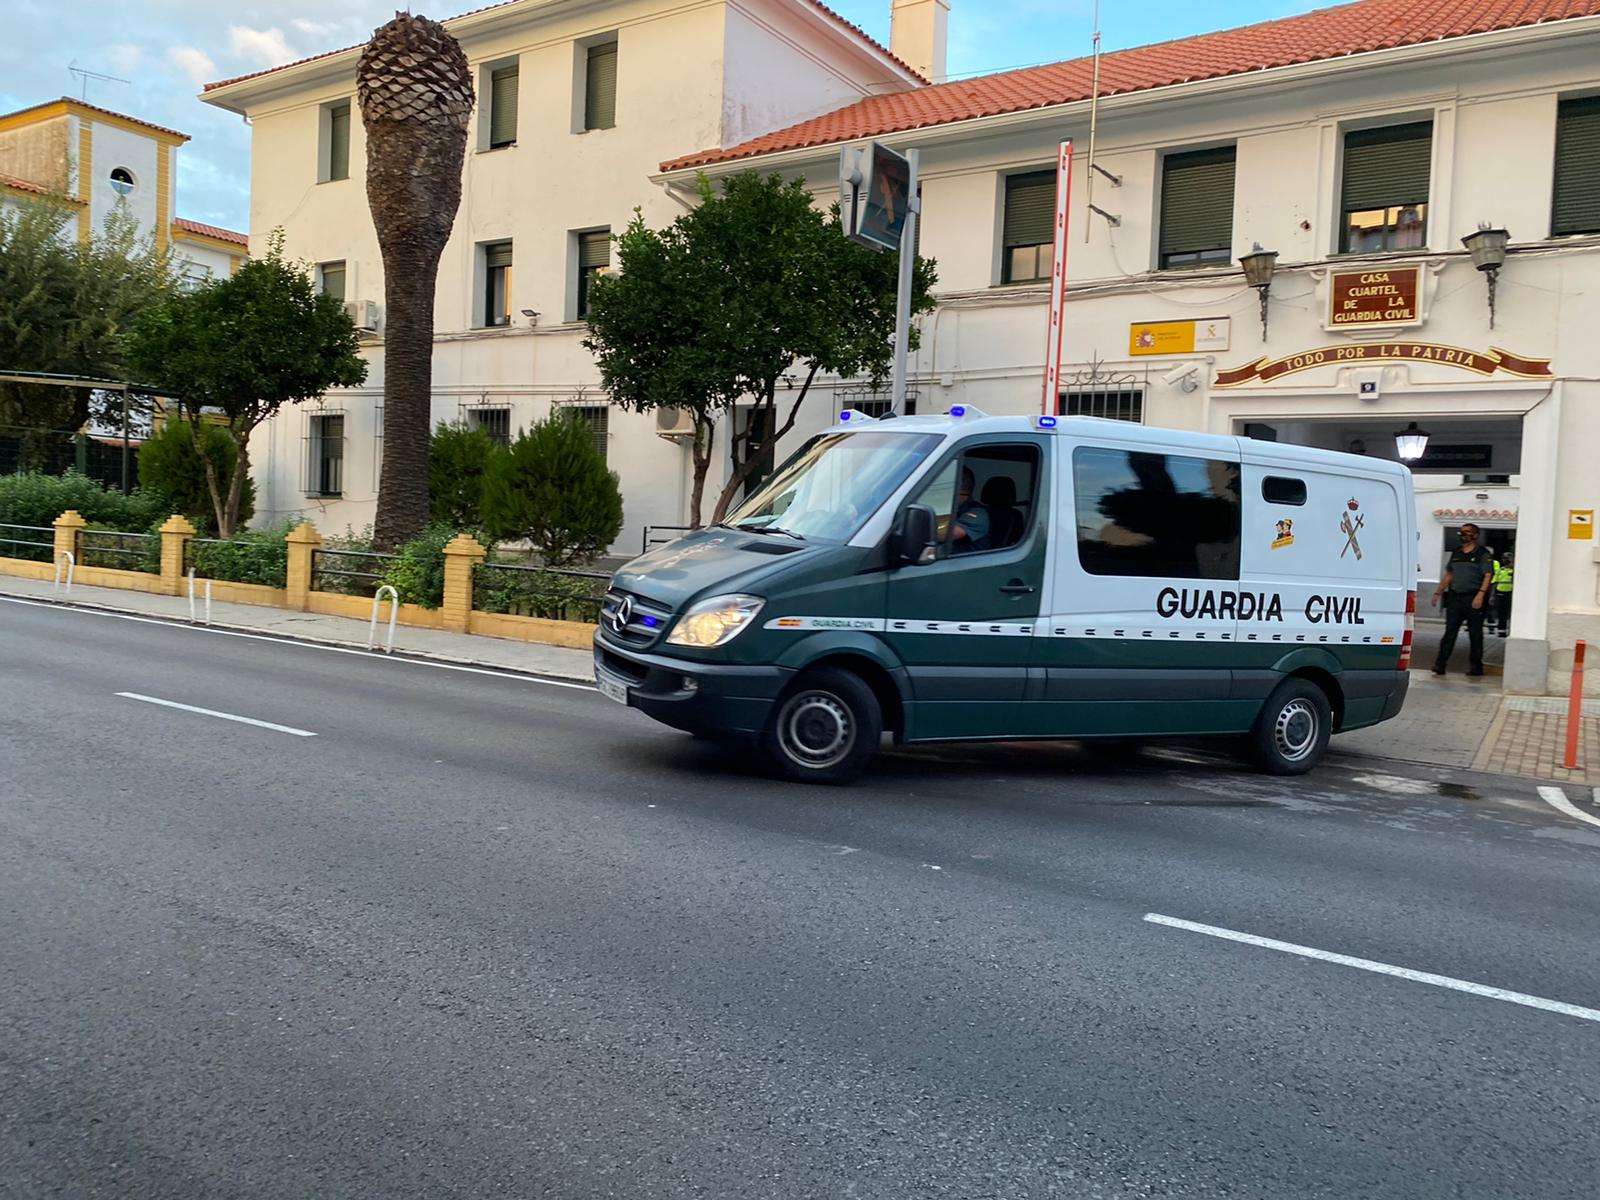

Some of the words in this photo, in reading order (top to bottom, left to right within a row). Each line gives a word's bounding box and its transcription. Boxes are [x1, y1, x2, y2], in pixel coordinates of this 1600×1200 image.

[1360, 273, 1389, 284] CASA
[1348, 285, 1399, 297] CUARTEL
[1343, 300, 1358, 309] DE
[1388, 297, 1404, 306] LA
[1334, 311, 1382, 322] GUARDIA
[1384, 309, 1413, 319] CIVIL
[1284, 352, 1324, 370] TODO
[1337, 348, 1365, 359] POR
[1380, 345, 1401, 356] LA
[1412, 347, 1474, 366] PATRIA
[1156, 587, 1283, 622] GUARDIA
[1304, 594, 1365, 625] CIVIL
[811, 619, 851, 628] GUARDIA
[854, 620, 875, 629] CIVIL
